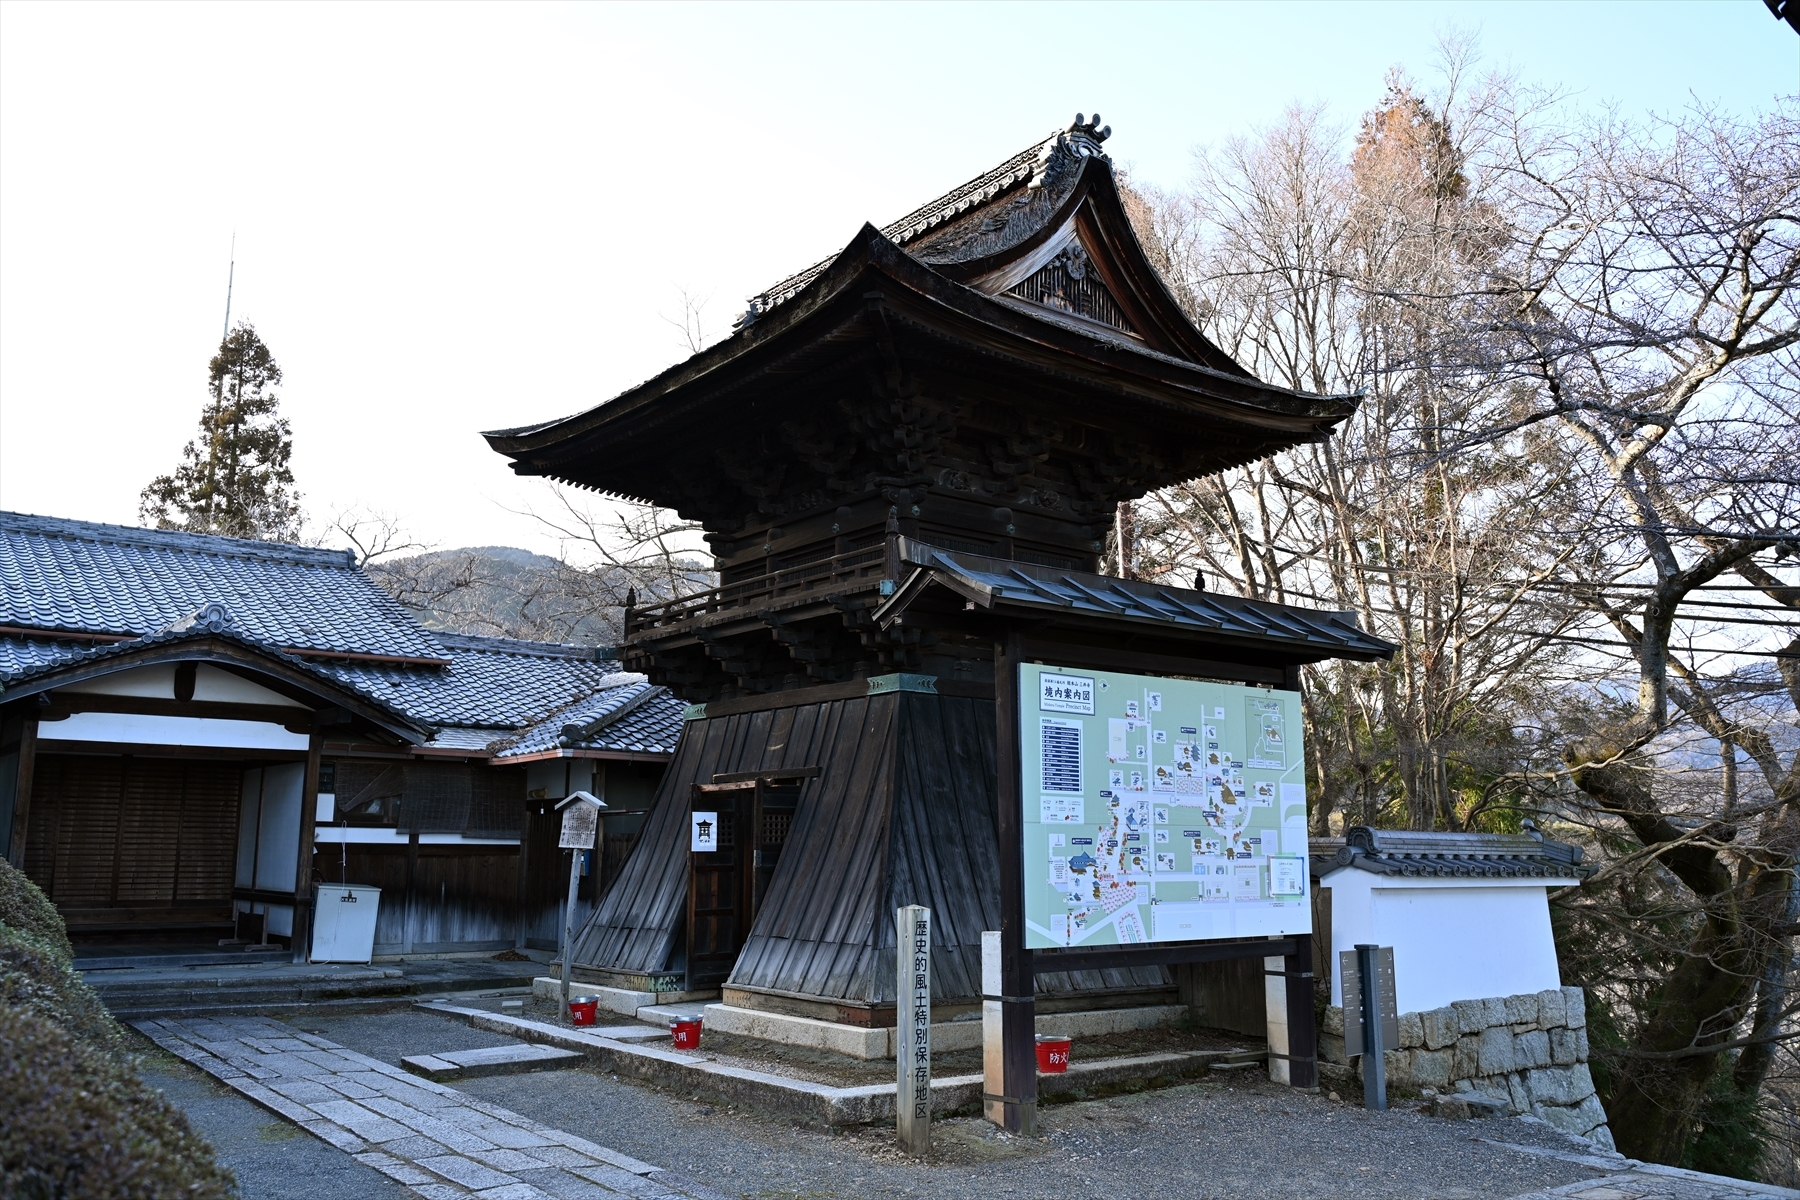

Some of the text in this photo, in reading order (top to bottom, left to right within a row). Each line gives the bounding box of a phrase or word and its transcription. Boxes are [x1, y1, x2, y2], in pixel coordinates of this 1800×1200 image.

[1045, 686, 1090, 700] 境内案内図
[915, 920, 927, 1119] 歴史的風土特別保存地区
